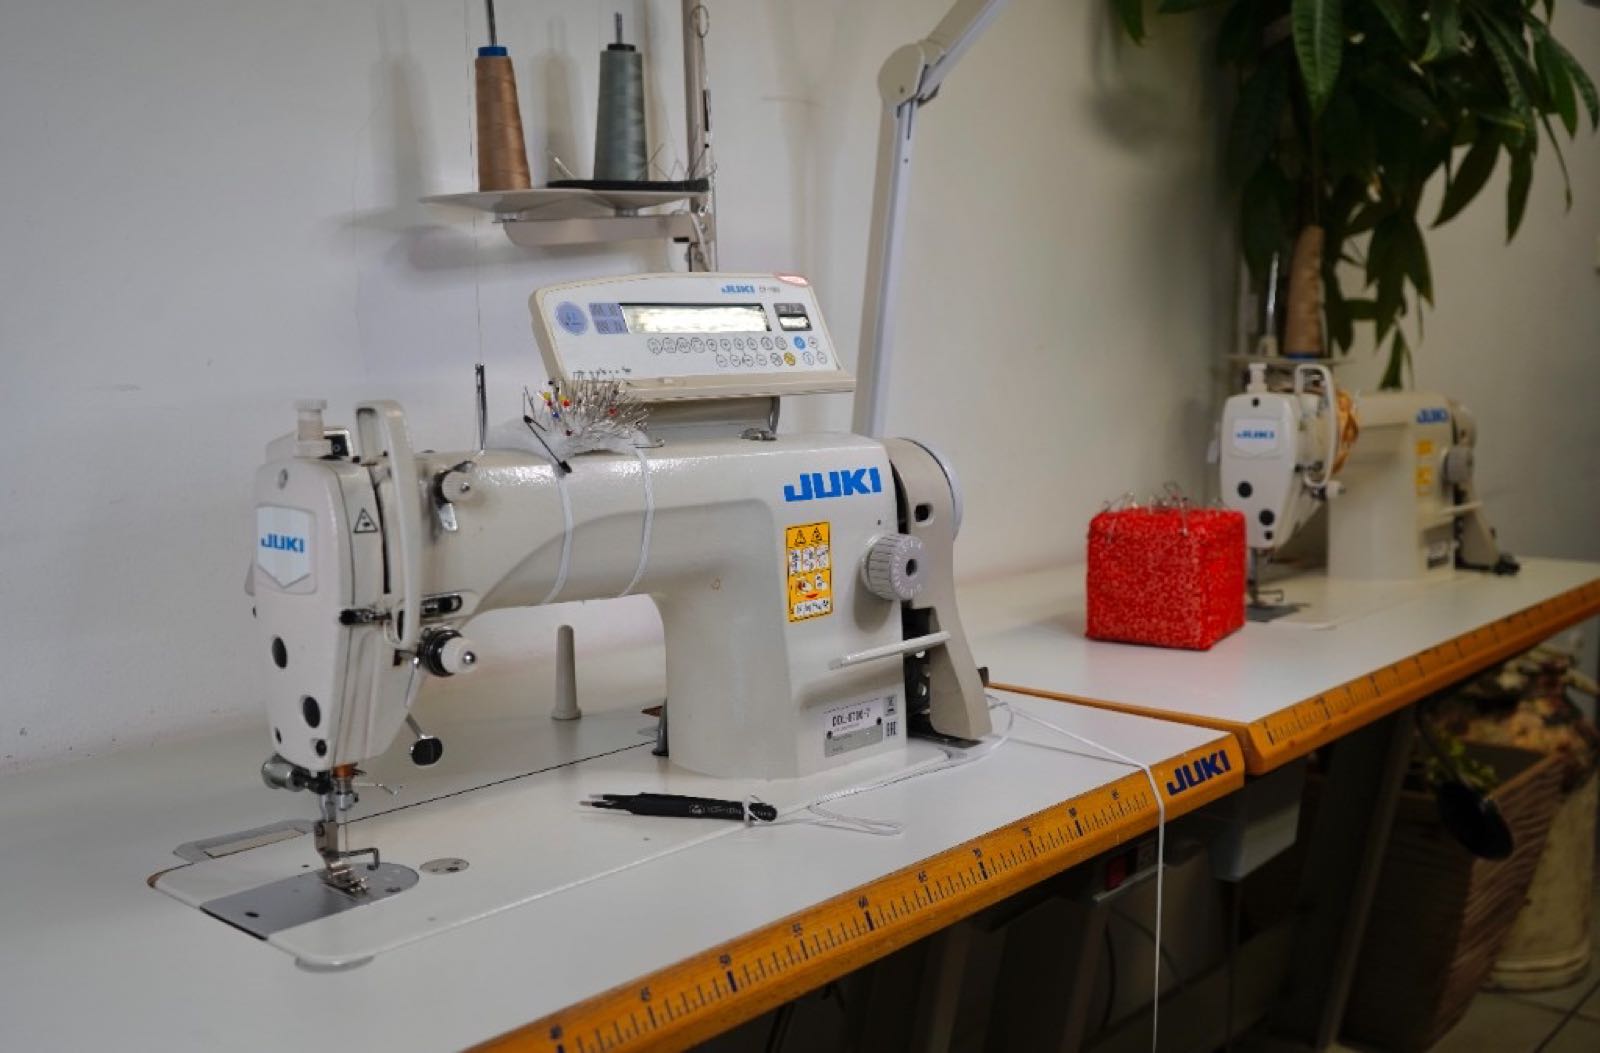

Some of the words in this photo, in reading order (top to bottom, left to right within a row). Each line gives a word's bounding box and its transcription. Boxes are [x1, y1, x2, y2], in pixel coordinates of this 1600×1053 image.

[721, 284, 756, 294] JUKI
[1236, 429, 1275, 440] JUKI
[783, 466, 882, 502] JUKI
[260, 532, 305, 553] JUKI
[1166, 750, 1232, 796] JUKI
